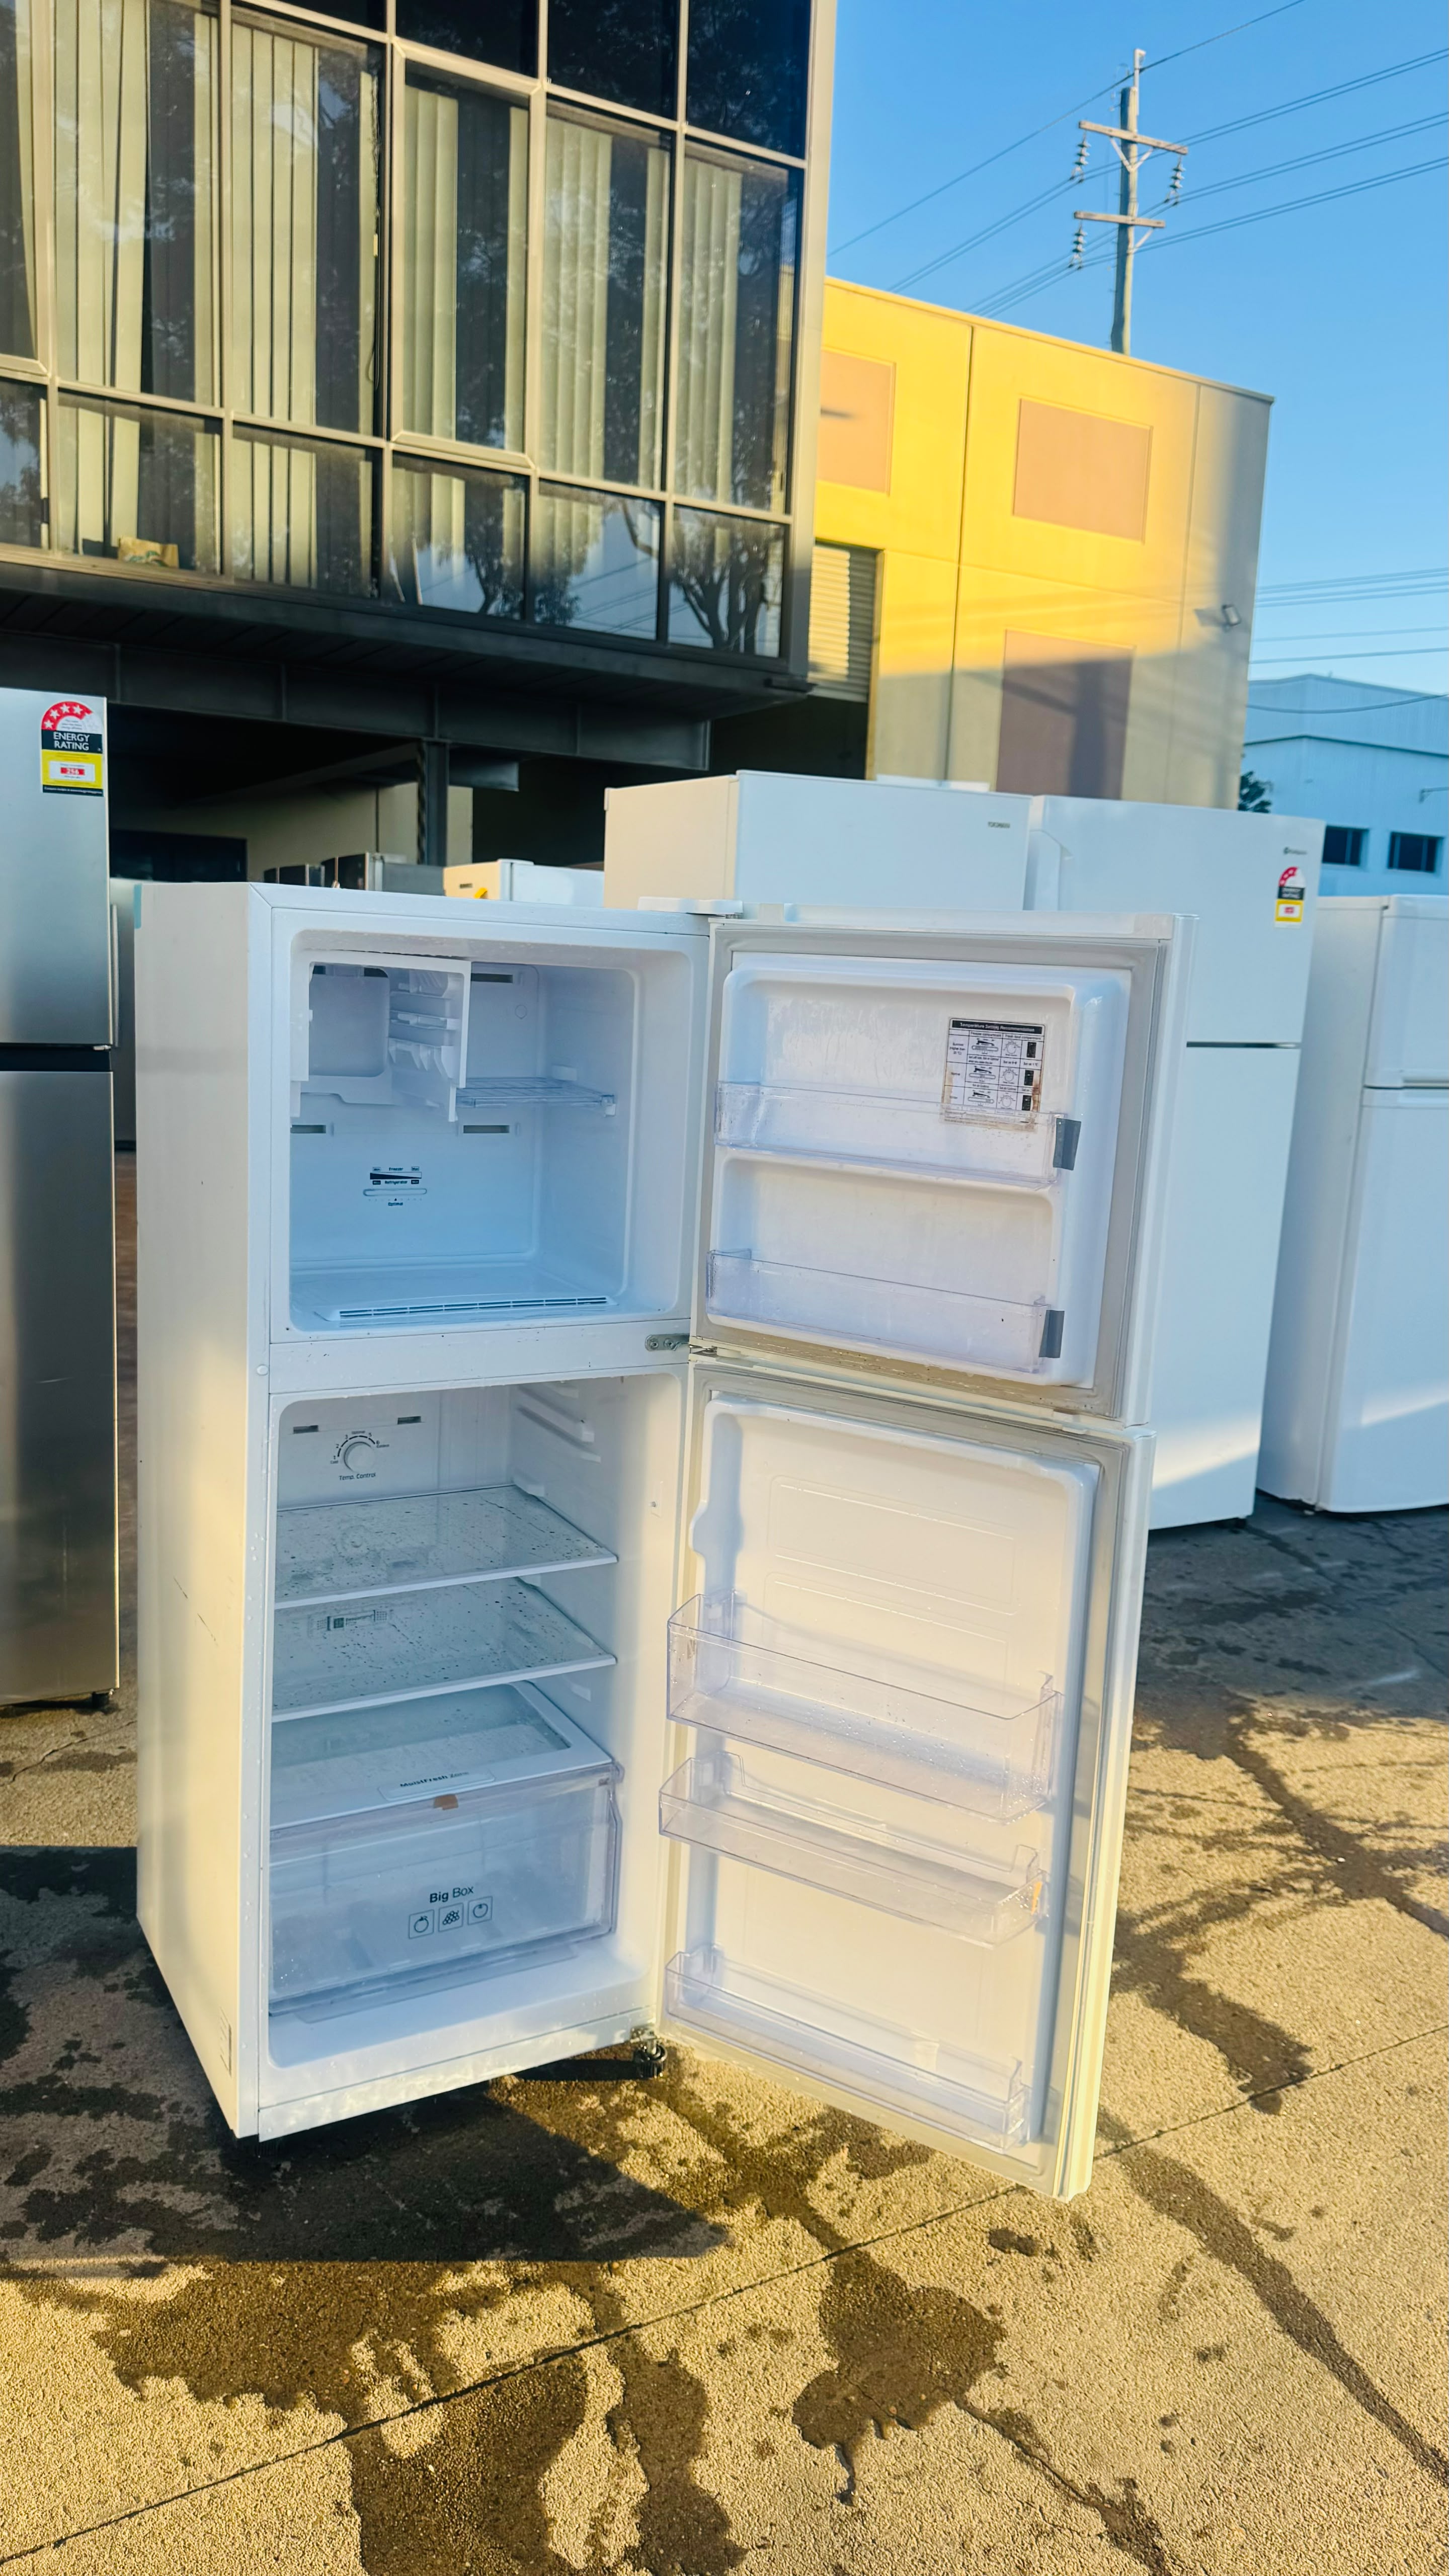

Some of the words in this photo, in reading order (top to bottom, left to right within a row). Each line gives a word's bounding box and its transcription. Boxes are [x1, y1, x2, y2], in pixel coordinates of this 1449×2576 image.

[53, 732, 90, 743] ENERGY
[54, 741, 90, 751] RATING
[400, 1775, 448, 1787] MoistFresh
[429, 1891, 449, 1903] Big
[452, 1886, 474, 1898] Box
